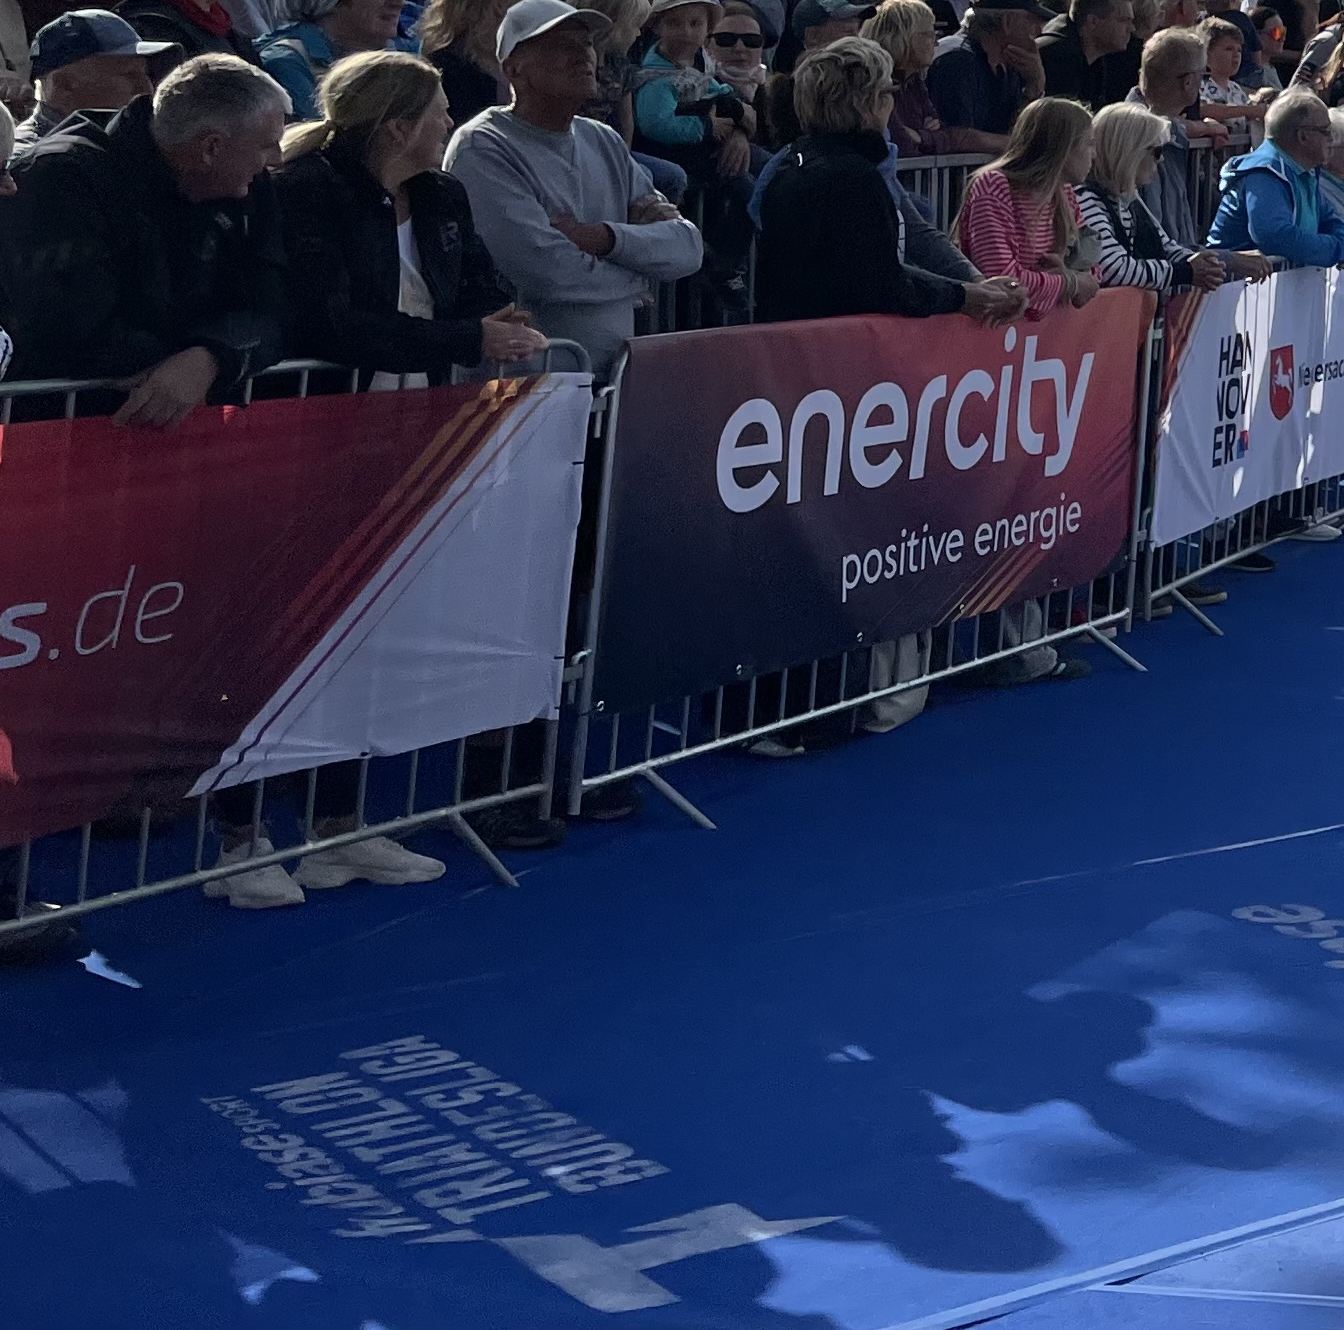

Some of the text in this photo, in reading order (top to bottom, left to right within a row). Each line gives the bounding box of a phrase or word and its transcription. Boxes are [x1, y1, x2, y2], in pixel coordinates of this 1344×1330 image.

[716, 326, 1096, 513] enercity
[1212, 422, 1237, 469] ER
[840, 492, 1082, 603] positive energie
[249, 1070, 554, 1225] TRIATHLON
[337, 1033, 672, 1196] BUNDESLIGA
